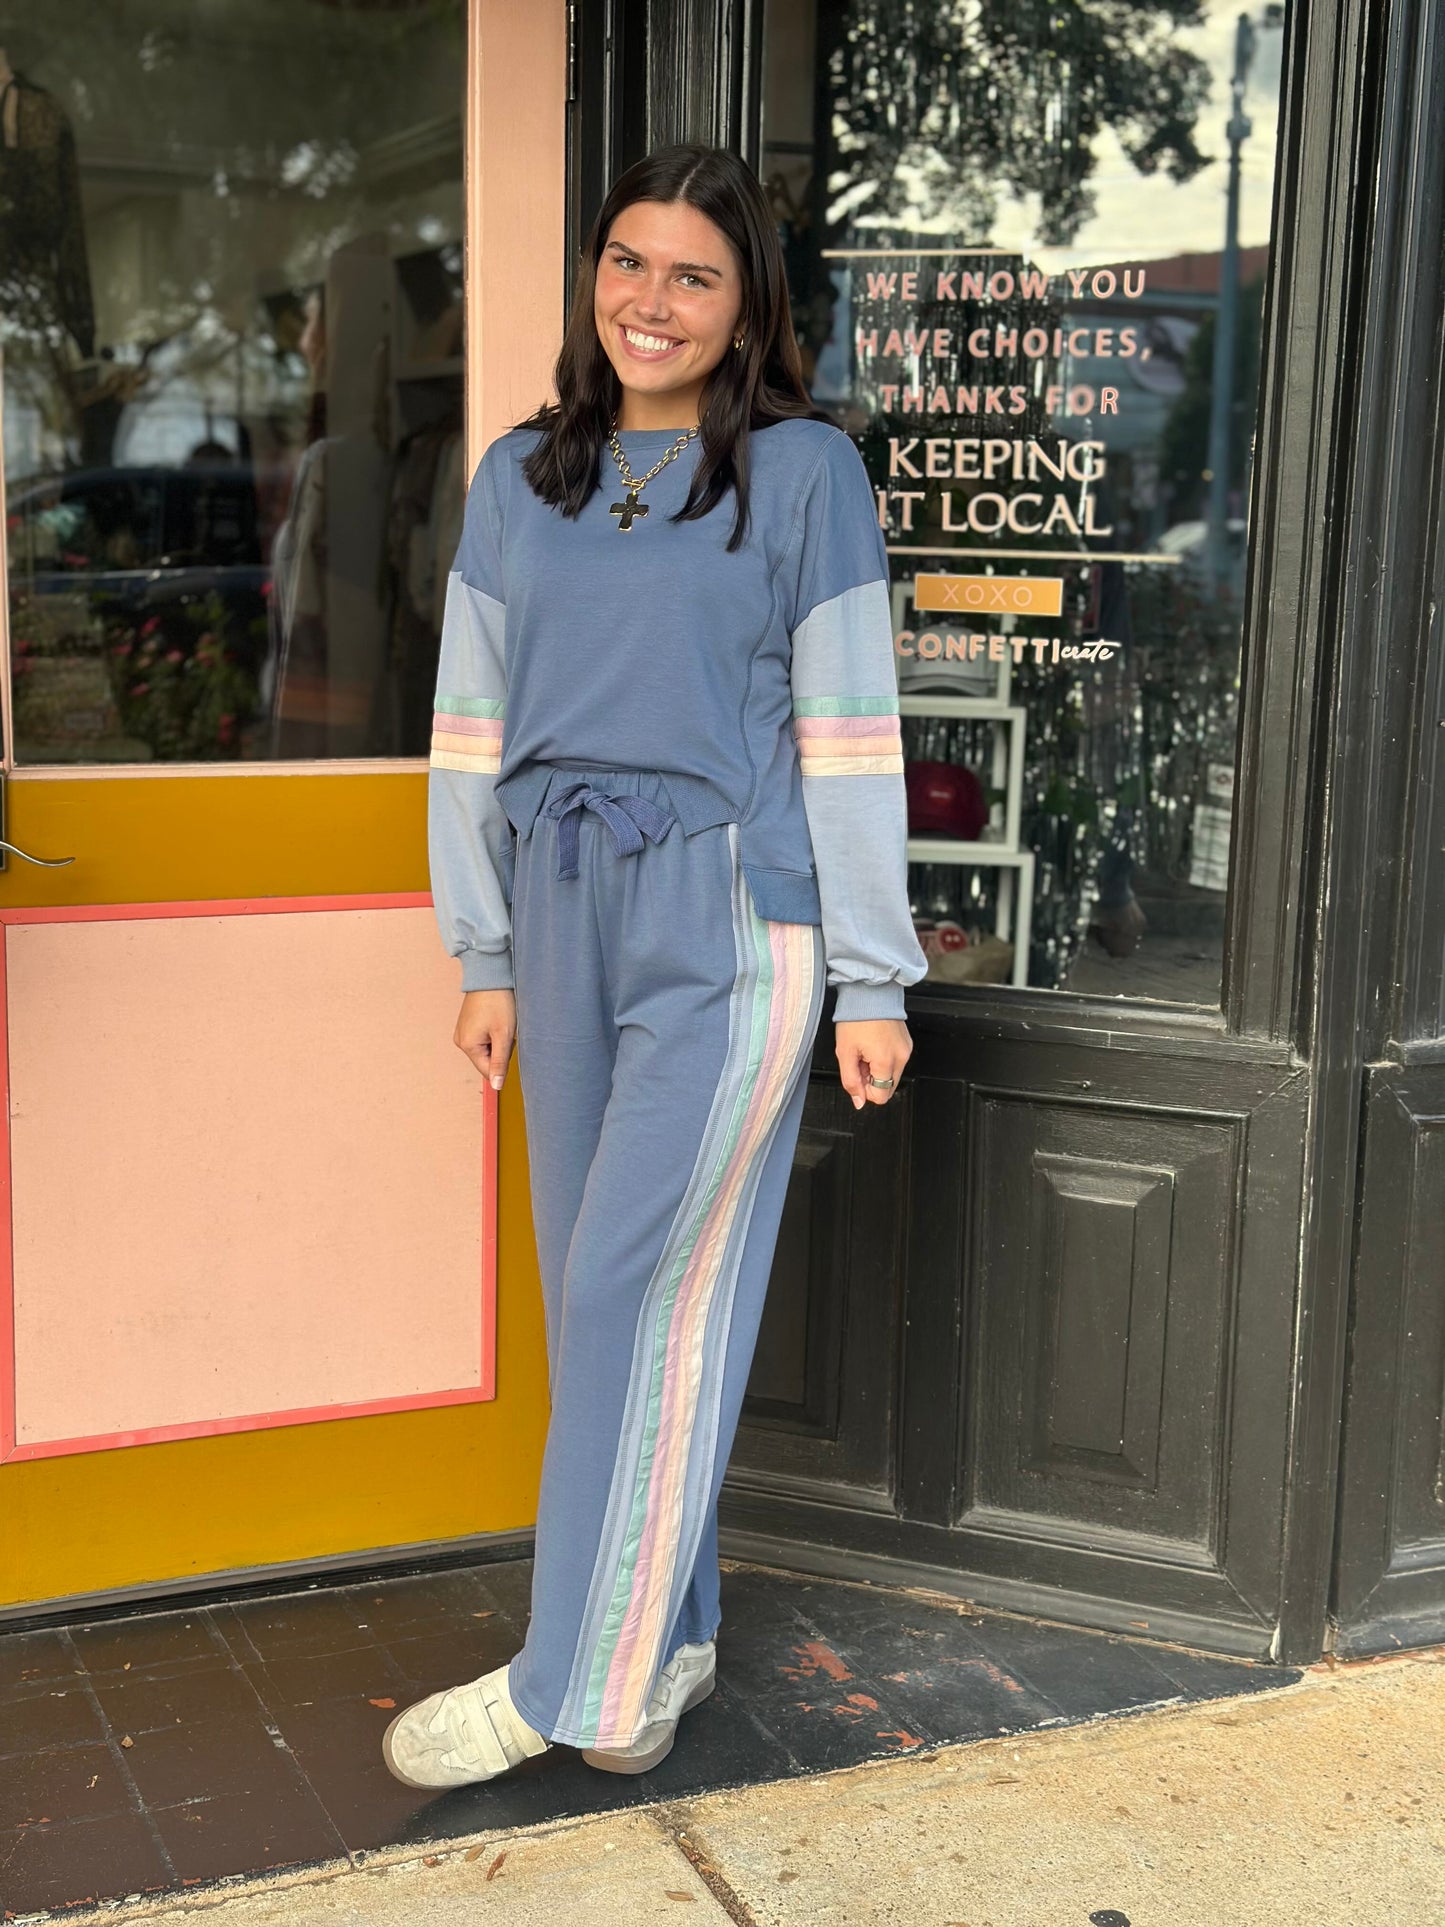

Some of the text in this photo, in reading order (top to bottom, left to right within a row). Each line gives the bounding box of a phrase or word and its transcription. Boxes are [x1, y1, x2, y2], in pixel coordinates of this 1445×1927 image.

[866, 269, 1146, 301] WE KNOW YOU
[857, 327, 1152, 362] HAVE CHOICES,
[879, 385, 1119, 416] THANKS FOR
[888, 437, 1106, 482] KEEPING
[876, 490, 1113, 536] IT LOCAL
[942, 583, 1033, 607] XOXO
[895, 629, 1122, 664] CONFETTI crate
